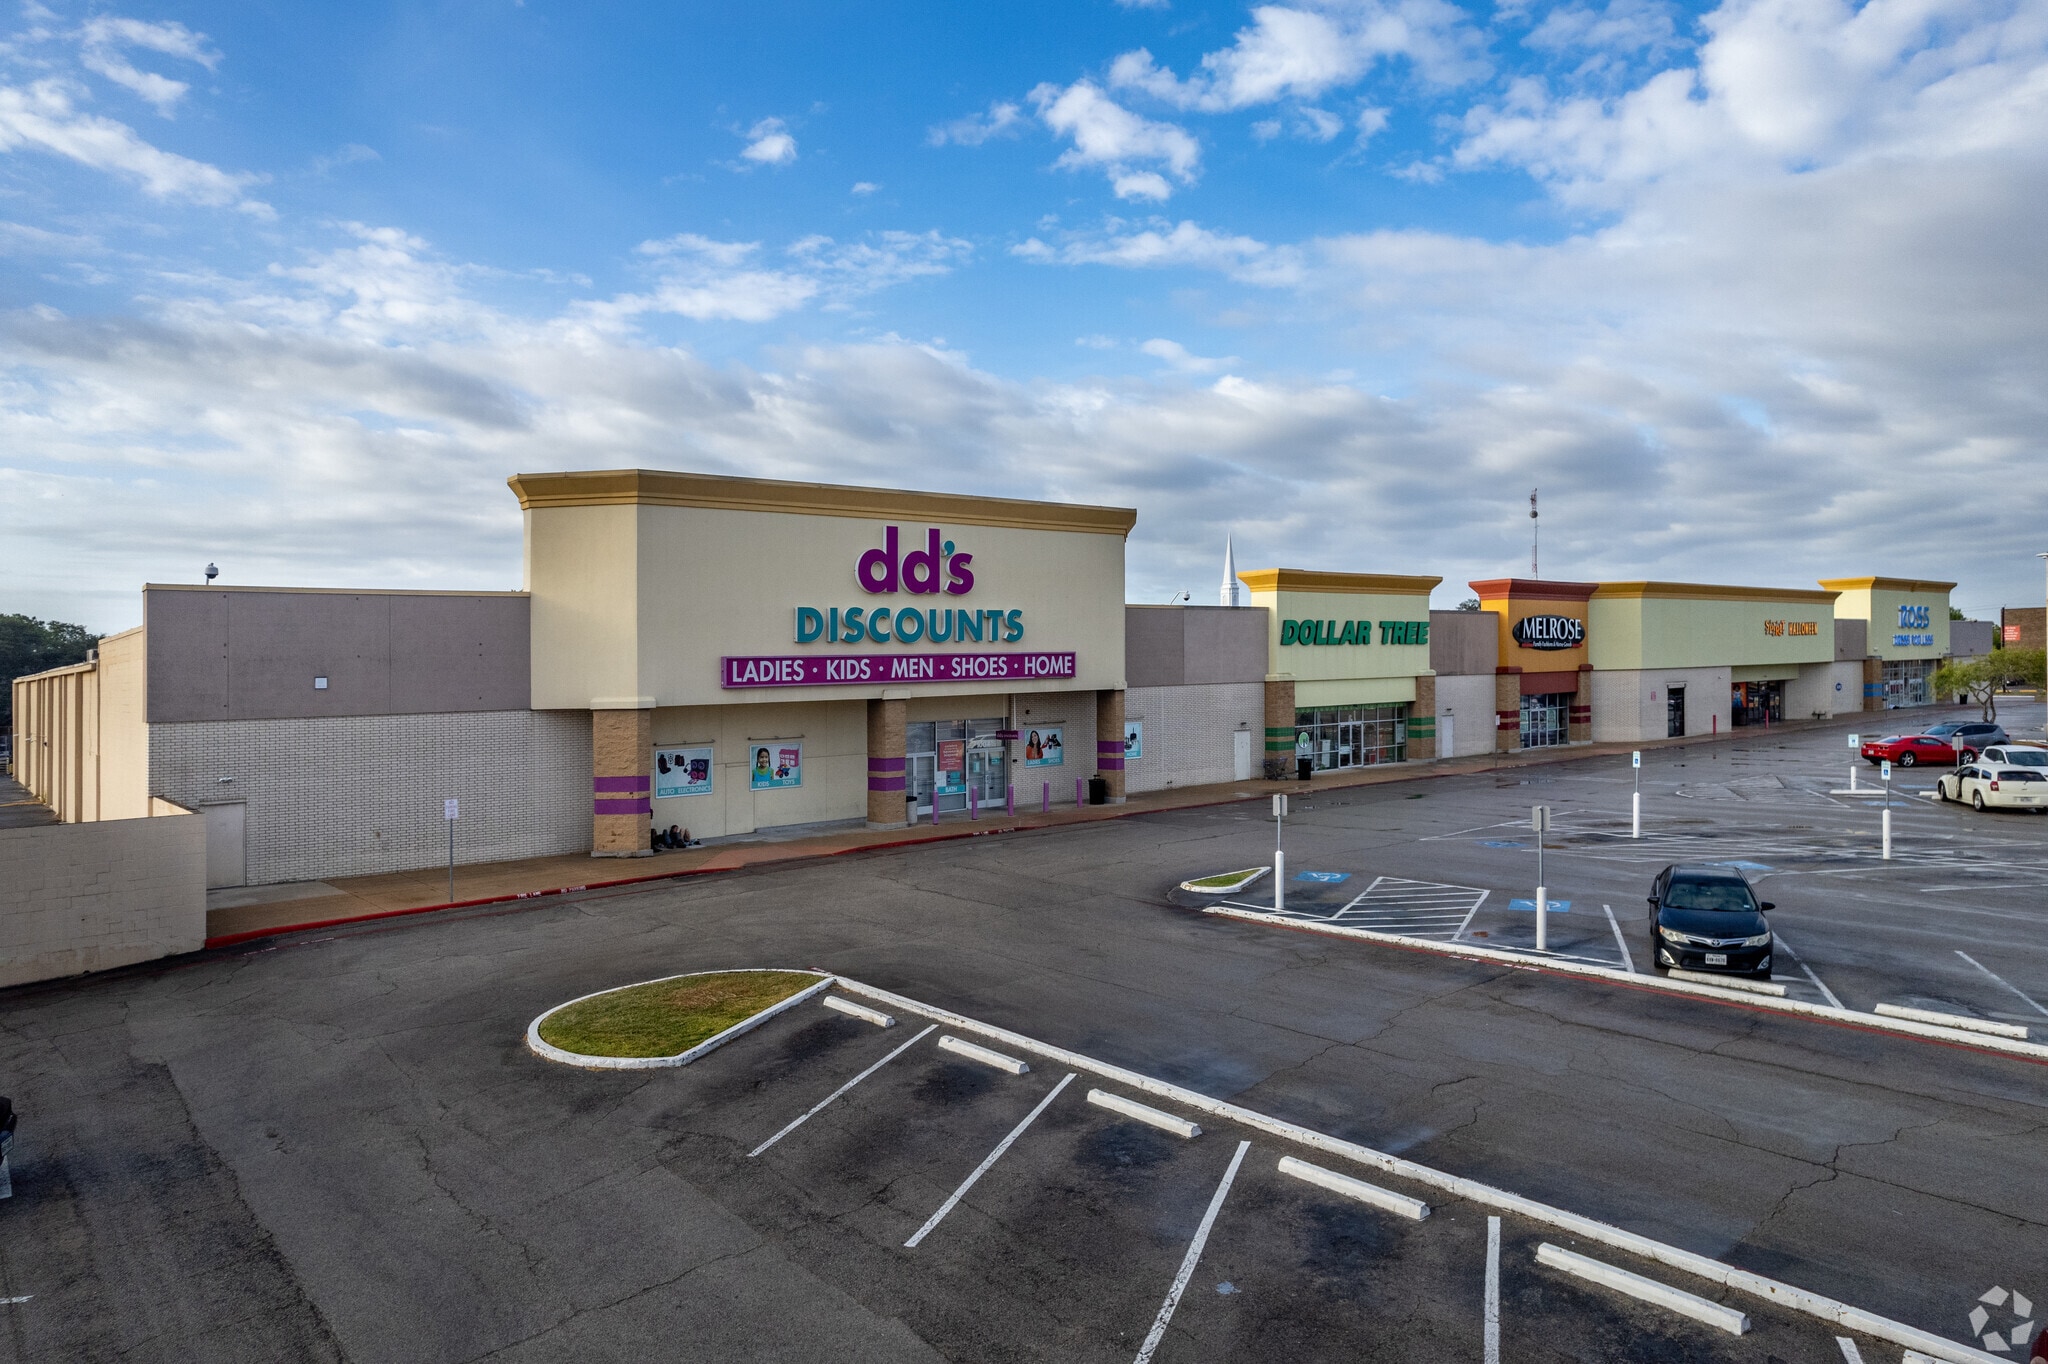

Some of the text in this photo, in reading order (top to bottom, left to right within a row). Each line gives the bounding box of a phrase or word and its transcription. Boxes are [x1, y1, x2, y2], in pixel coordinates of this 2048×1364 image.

[856, 525, 975, 595] dd's
[795, 606, 1025, 643] DISCOUNTS
[1523, 617, 1581, 639] MELROSE
[1788, 621, 1818, 636] HALLOWEEN
[1898, 605, 1930, 628] ROSS
[1280, 619, 1430, 646] DOLLAR TREE
[732, 655, 1072, 683] LADIES KIDS MEN SHOES HOME
[660, 785, 711, 795] AUTO ELECTRONICS
